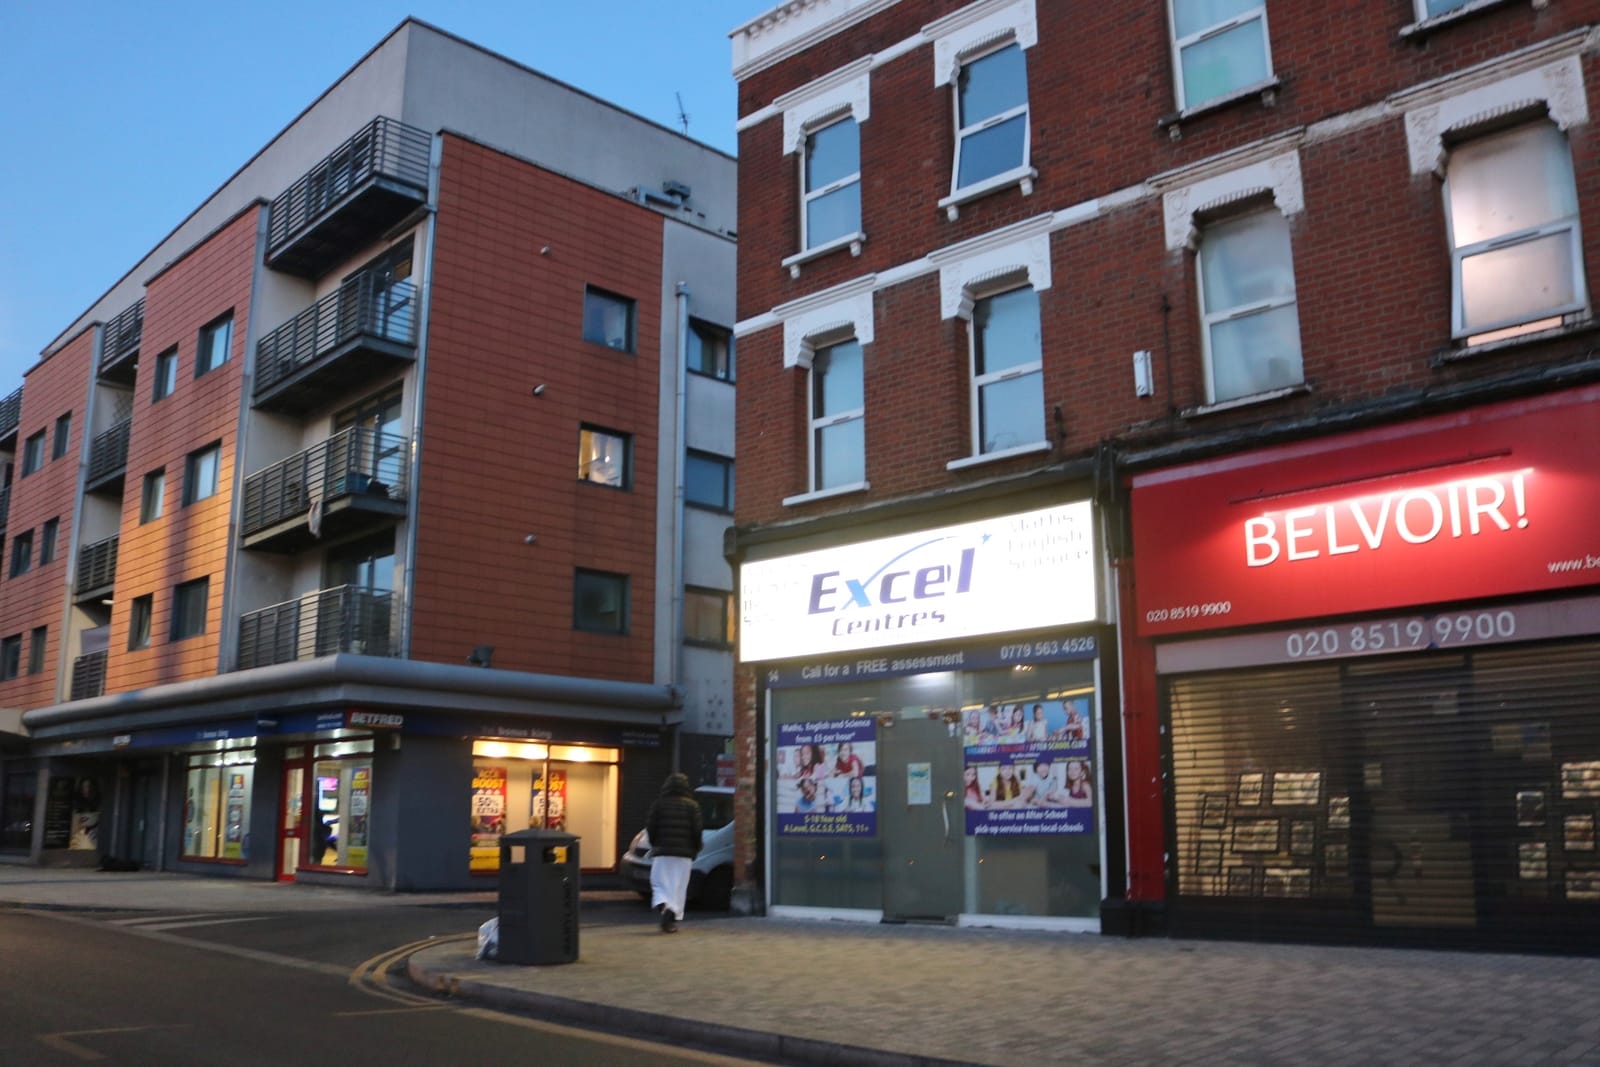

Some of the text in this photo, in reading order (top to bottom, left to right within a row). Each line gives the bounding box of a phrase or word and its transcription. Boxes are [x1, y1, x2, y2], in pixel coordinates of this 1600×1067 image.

[1244, 473, 1529, 568] BELVOIR!
[808, 547, 976, 615] Excel
[831, 608, 946, 637] Centres
[1146, 600, 1232, 623] 020 8519 9900
[1000, 643, 1032, 660] 0779
[1062, 635, 1096, 654] 4526
[1286, 610, 1517, 658] 020 8519 9900
[801, 651, 965, 680] Call for a FREE assessment
[350, 711, 404, 726] BETFRED
